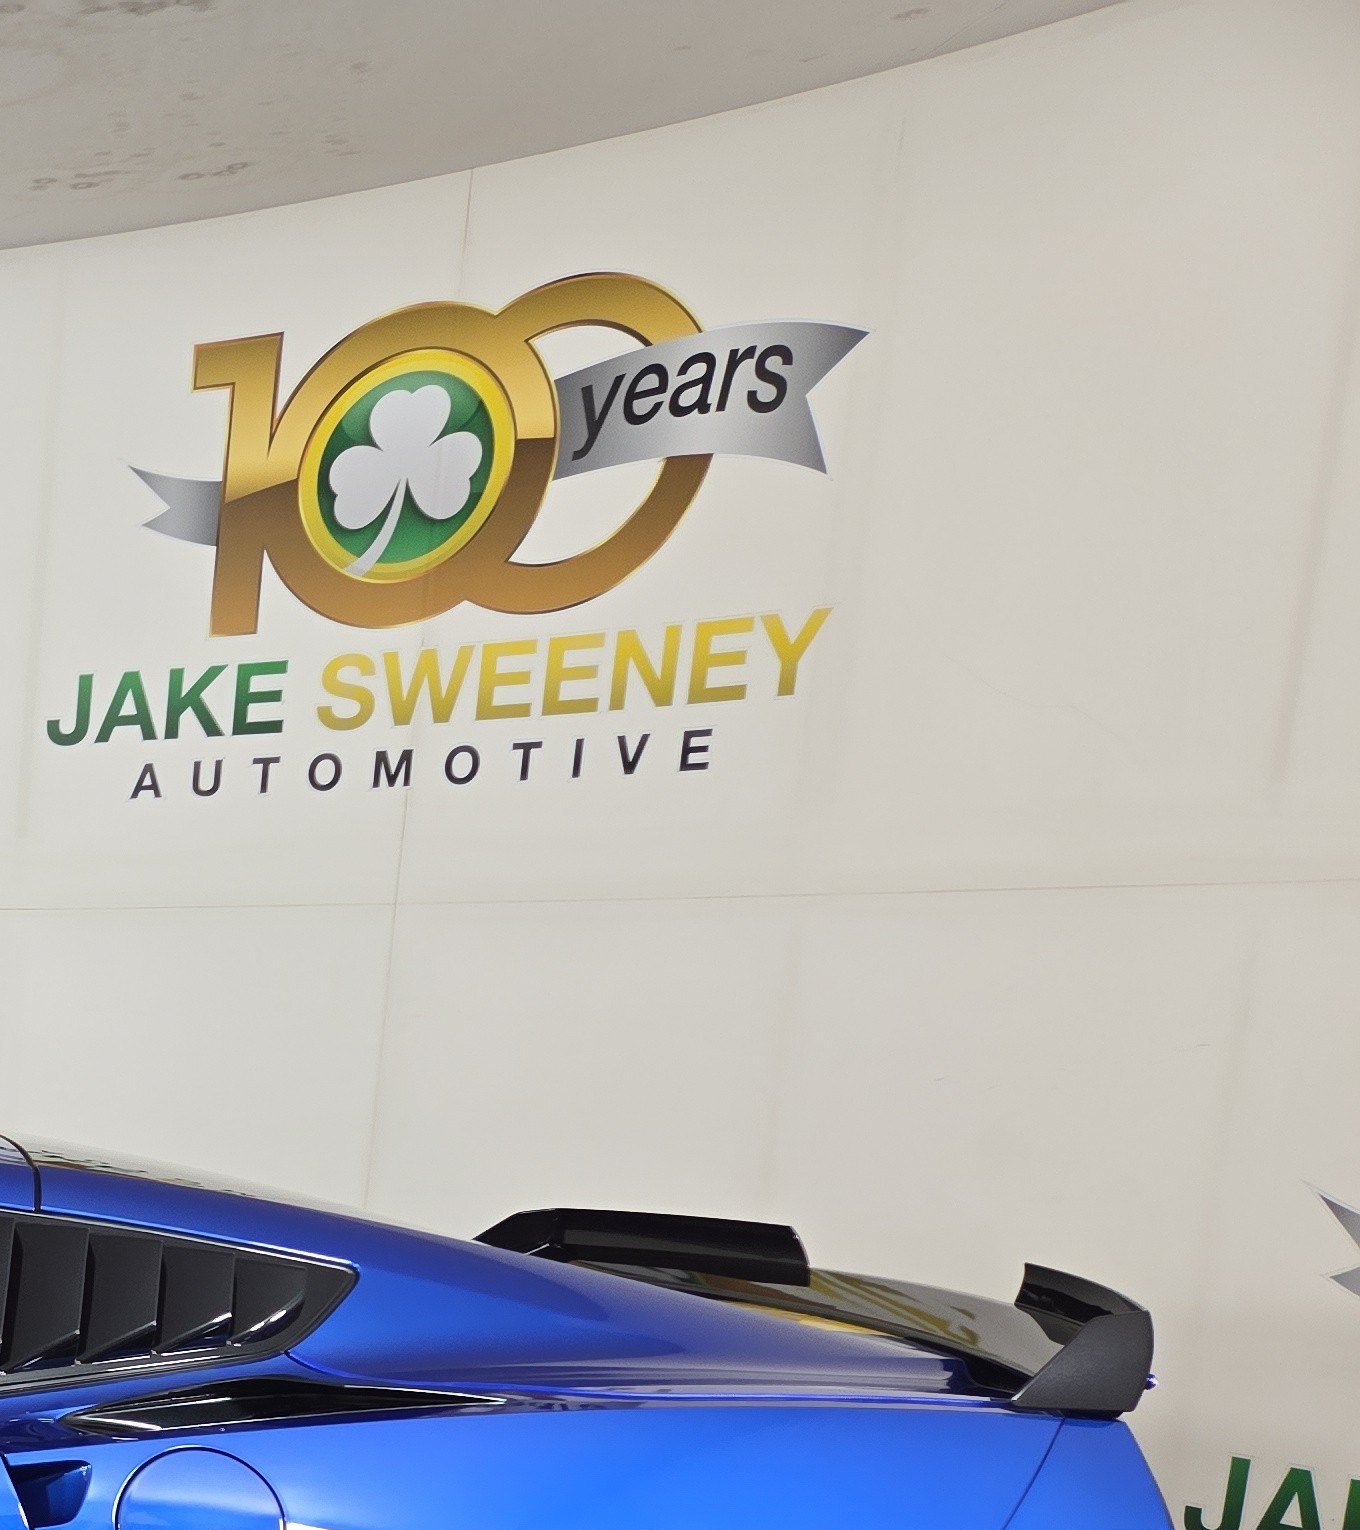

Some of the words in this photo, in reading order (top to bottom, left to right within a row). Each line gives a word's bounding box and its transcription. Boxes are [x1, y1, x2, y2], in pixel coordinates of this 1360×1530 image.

[192, 271, 716, 638] 100
[573, 343, 794, 460] years
[46, 660, 289, 747] JAKE
[316, 607, 833, 731] SWEENEY
[131, 728, 714, 800] AUTOMOTIVE
